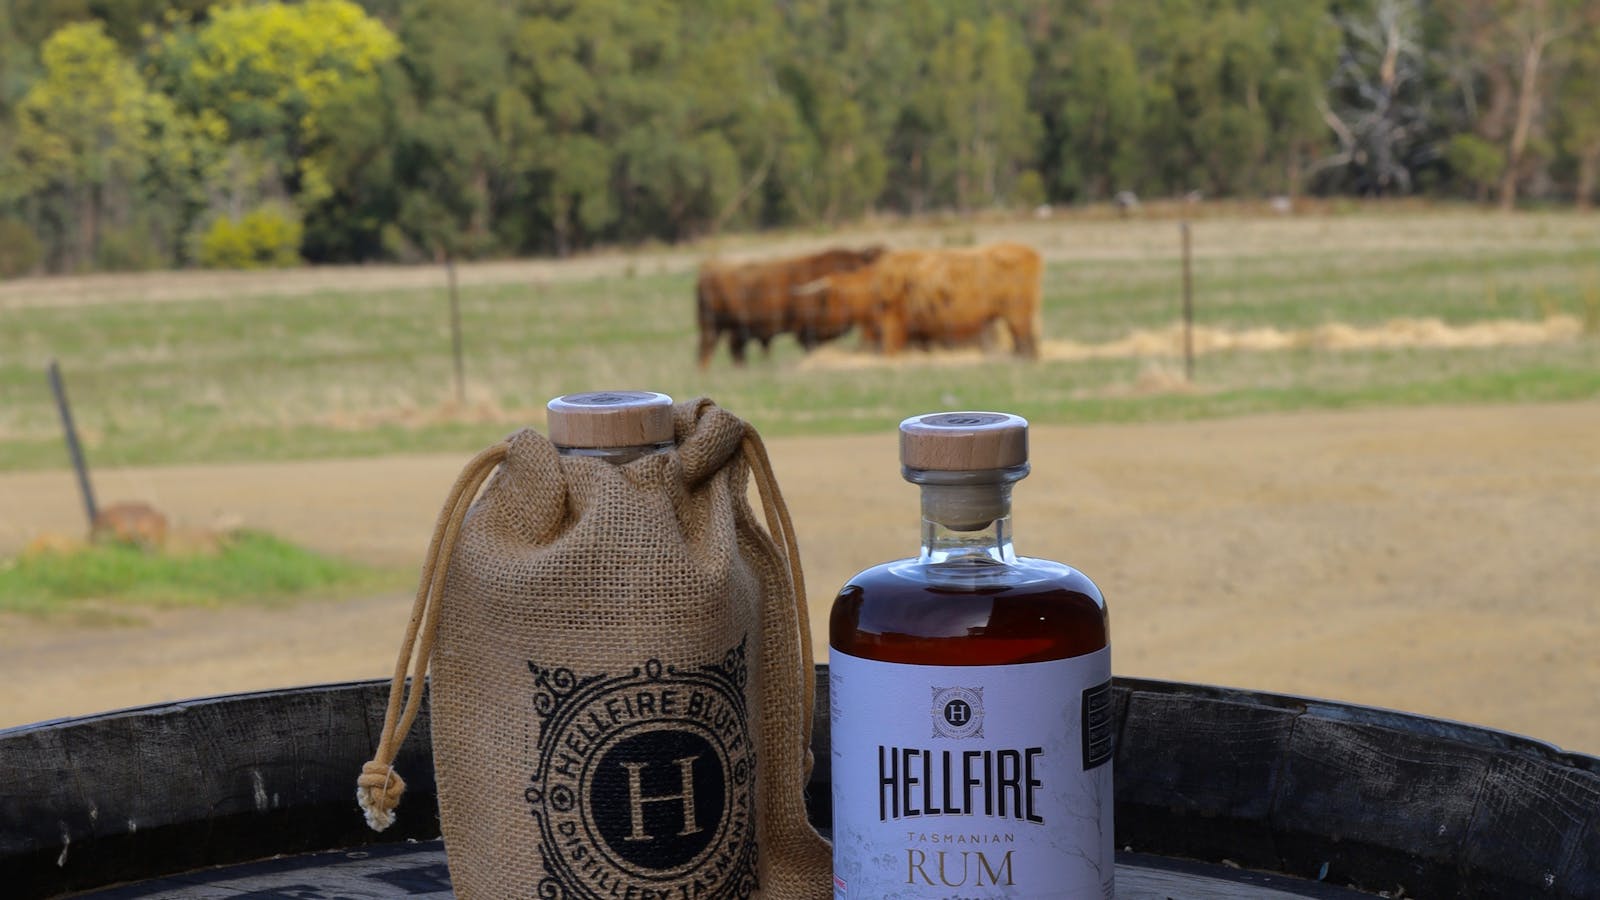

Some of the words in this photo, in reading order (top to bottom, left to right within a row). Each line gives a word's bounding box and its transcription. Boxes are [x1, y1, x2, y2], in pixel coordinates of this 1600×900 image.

[556, 690, 677, 778] HELLFIRE
[687, 691, 742, 752] BLUFF
[948, 704, 967, 722] H
[619, 755, 704, 842] H
[878, 745, 1046, 825] HELLFIRE
[557, 821, 671, 900] DISTILLERY
[678, 792, 748, 900] TASMANIA
[904, 848, 1017, 888] RUM
[907, 831, 1015, 844] TASMANIAN
